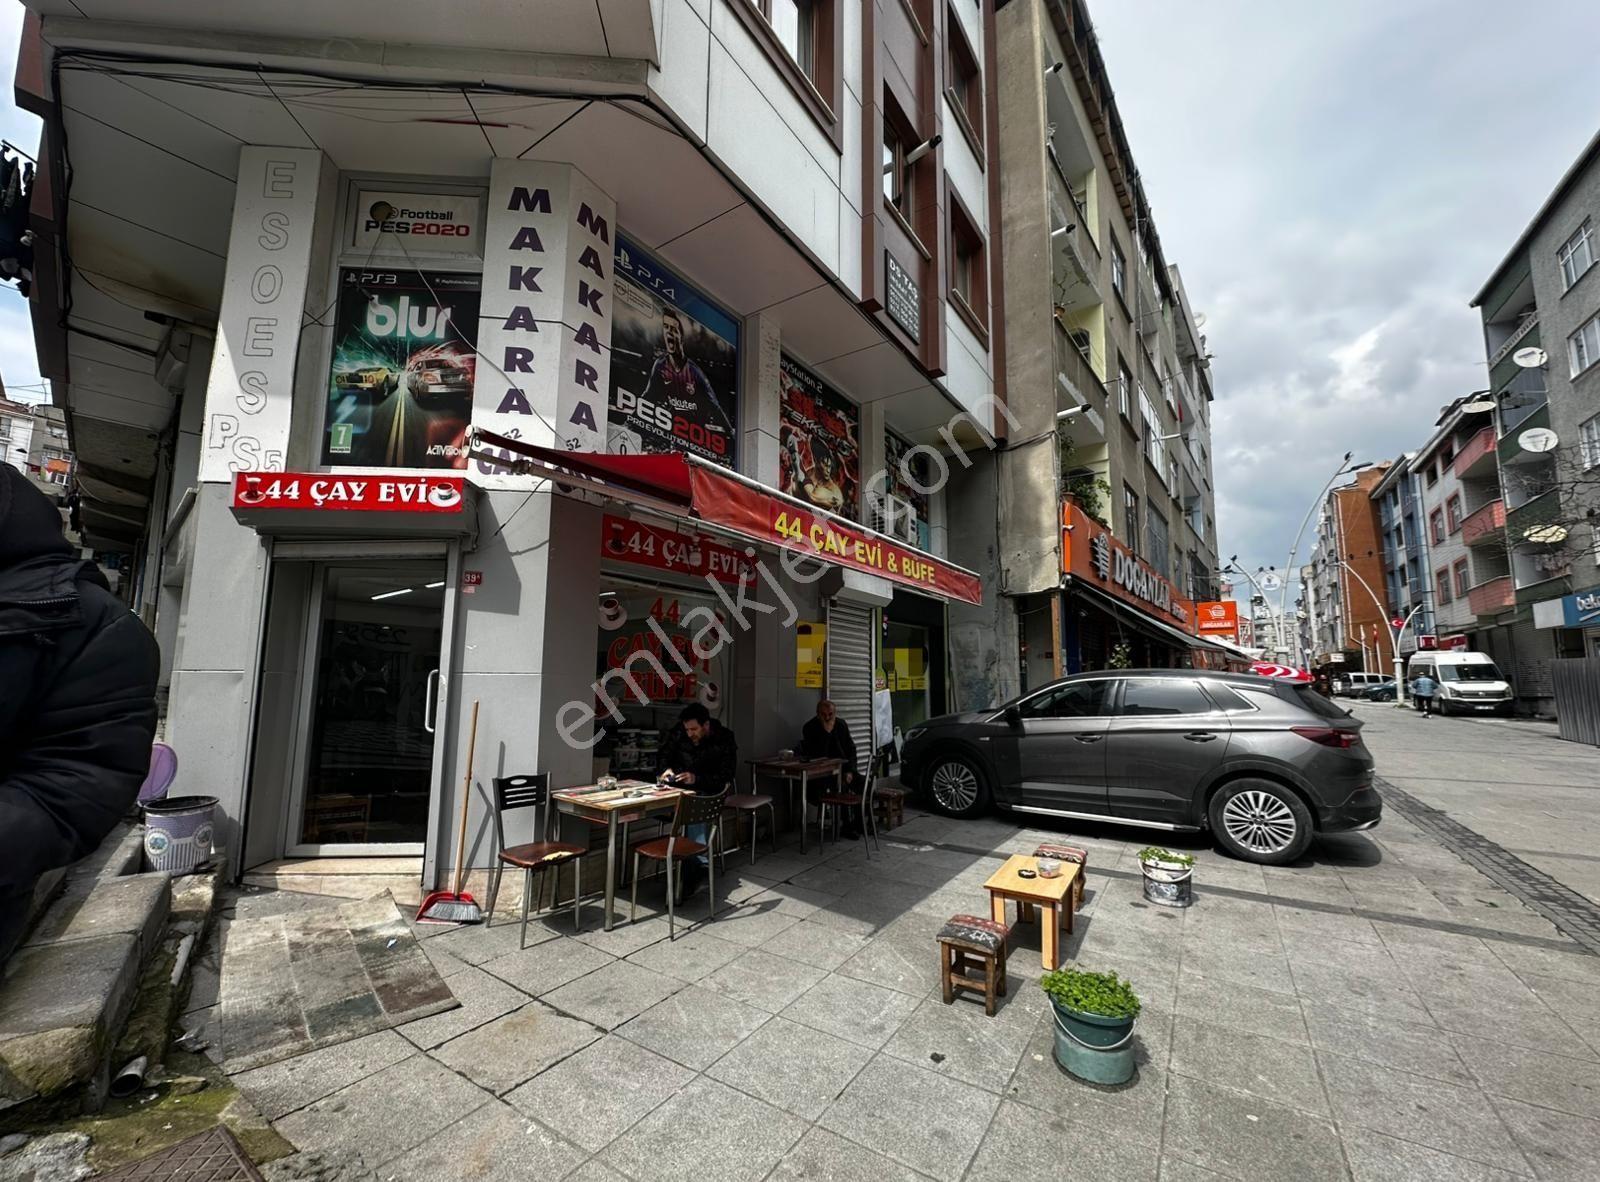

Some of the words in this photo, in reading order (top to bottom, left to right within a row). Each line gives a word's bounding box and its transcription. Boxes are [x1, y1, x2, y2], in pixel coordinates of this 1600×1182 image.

[361, 273, 397, 284] PS3
[637, 264, 676, 300] PS4
[367, 295, 451, 338] blur
[495, 187, 552, 415] MAKARA
[569, 202, 610, 432] MAKARA
[337, 426, 347, 445] 7
[616, 386, 727, 455] PES2019
[627, 414, 645, 429] PRO
[646, 421, 689, 448] EVOLUTION
[689, 442, 717, 459] SOCCER
[265, 479, 300, 499] 44
[310, 480, 368, 506] ÇAY
[378, 478, 429, 503] EVİ
[628, 531, 655, 557] 44
[709, 550, 739, 575] EVİ
[774, 511, 803, 543] 44
[809, 523, 850, 557] ÇAY
[854, 540, 883, 569] EVİ
[887, 551, 898, 574] &
[902, 556, 936, 585] BÜFE
[650, 597, 680, 624] 44
